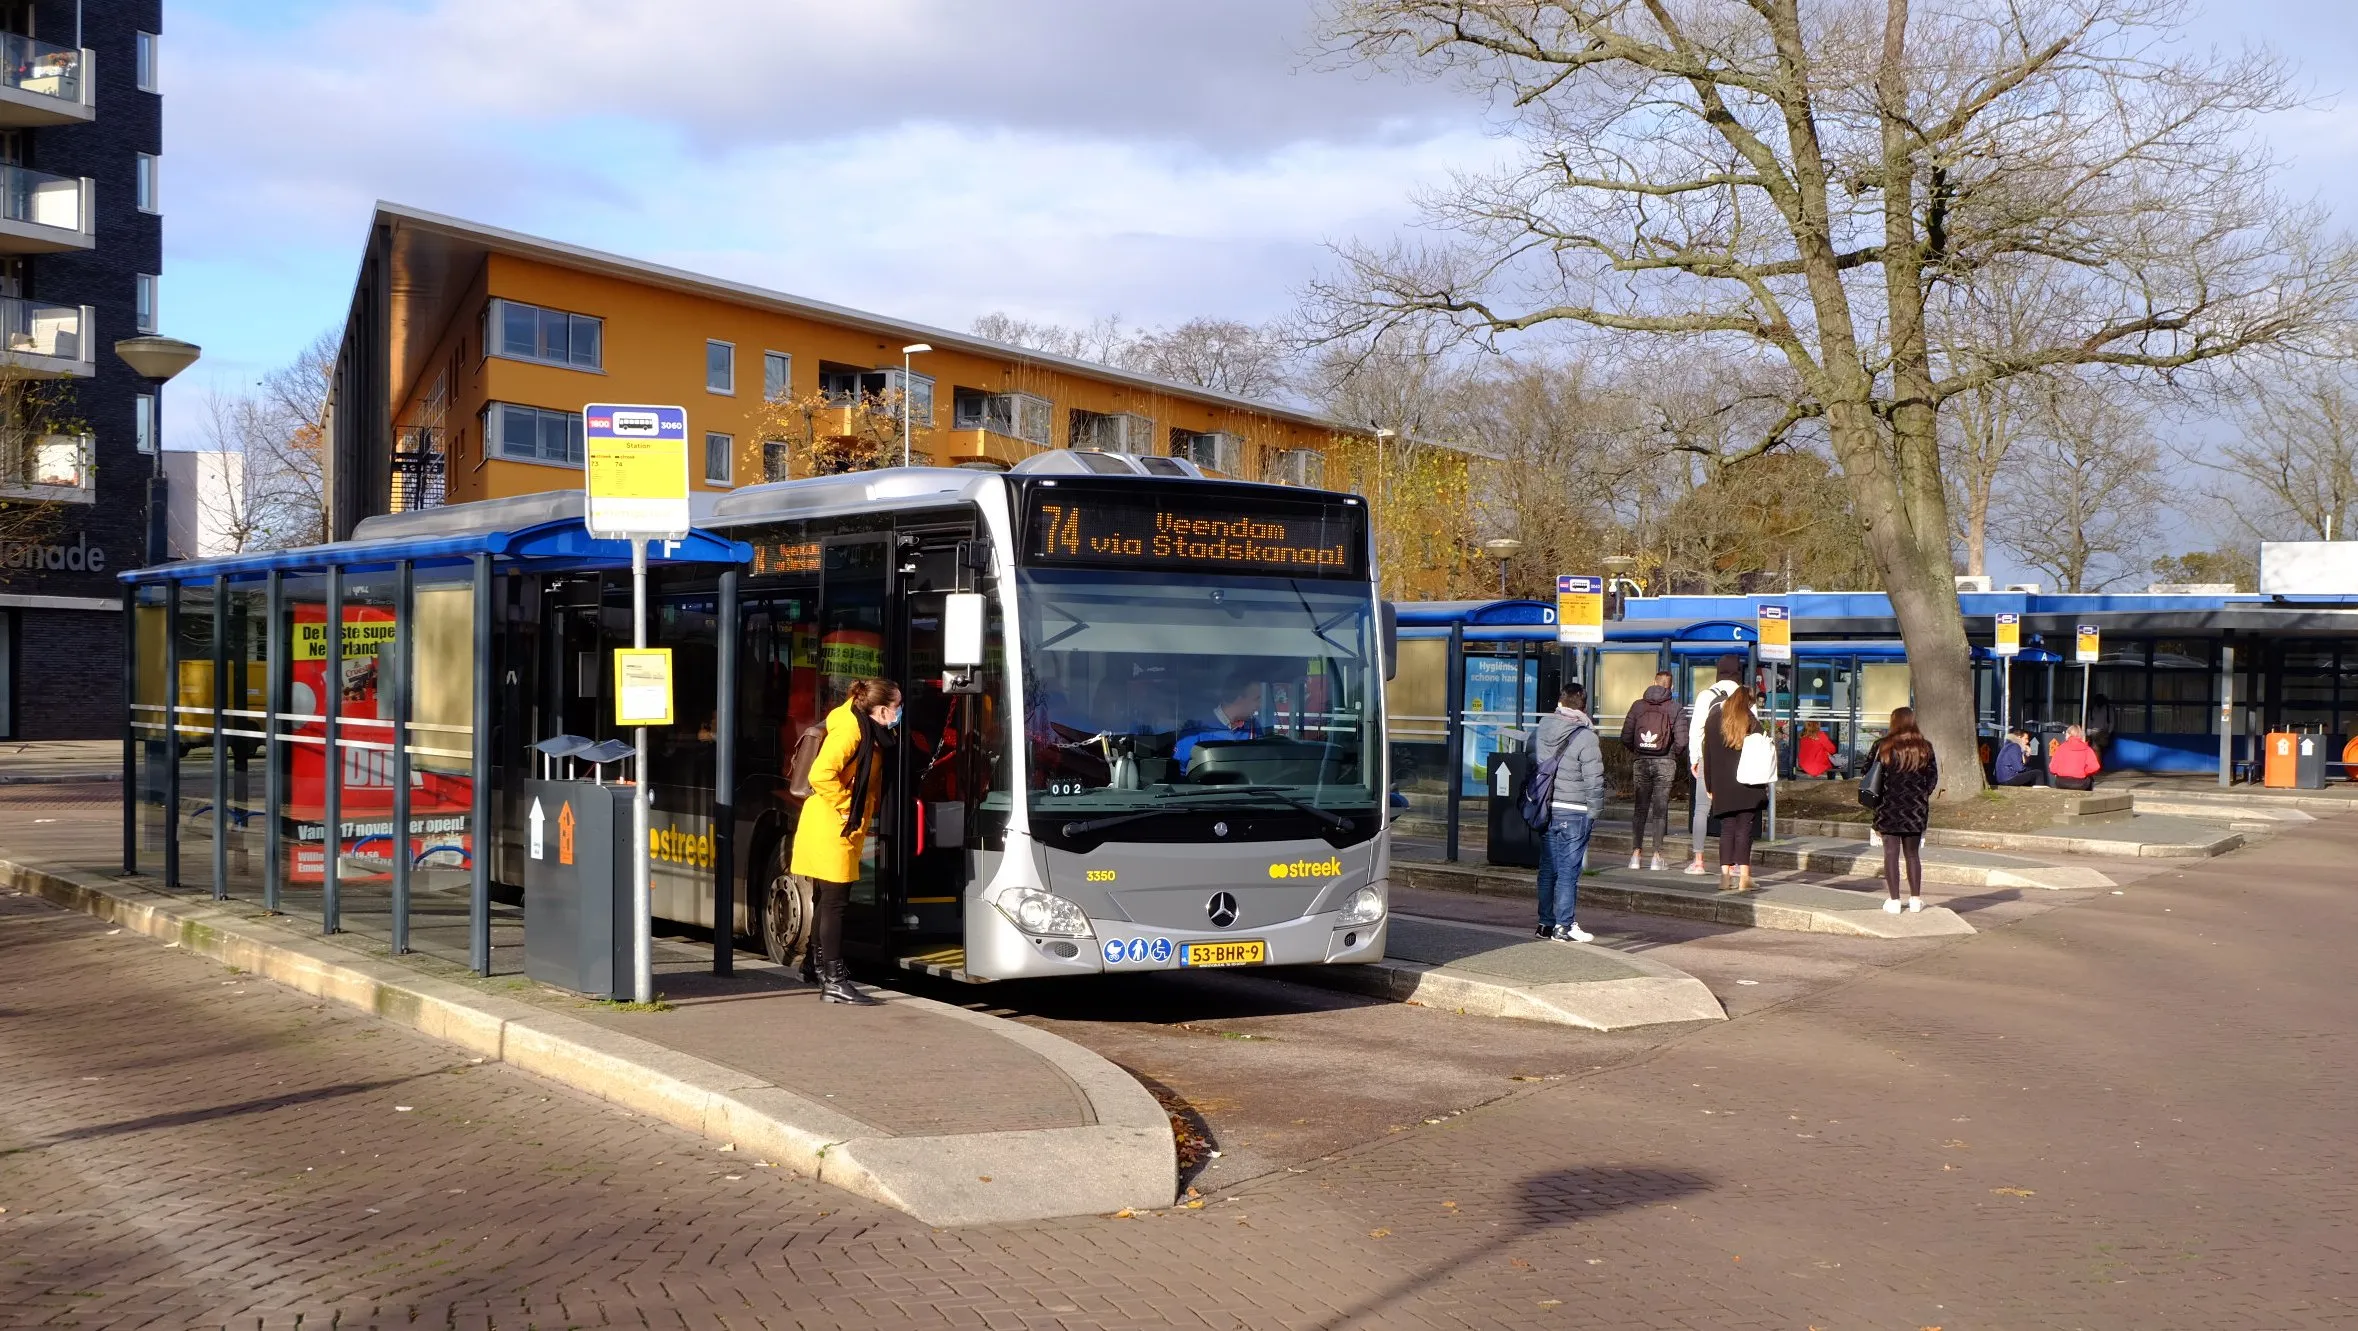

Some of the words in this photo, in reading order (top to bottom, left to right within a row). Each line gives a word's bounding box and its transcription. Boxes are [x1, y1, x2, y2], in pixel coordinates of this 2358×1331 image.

[1042, 505, 1080, 554] 74
[1156, 512, 1285, 540] Veendam
[1091, 533, 1142, 555] via
[1153, 535, 1345, 565] Stadskanaal
[1543, 608, 1554, 623] D
[303, 627, 320, 640] De
[363, 625, 396, 640] supe
[1733, 627, 1742, 640] C
[309, 642, 378, 656] Nerland
[2041, 652, 2047, 661] A
[1480, 661, 1518, 672] Hygiënisc
[340, 823, 353, 838] 17
[426, 816, 465, 834] open!
[1289, 857, 1341, 878] streek
[1086, 870, 1116, 882] 3350
[1193, 945, 1259, 962] 53-BHR-9
